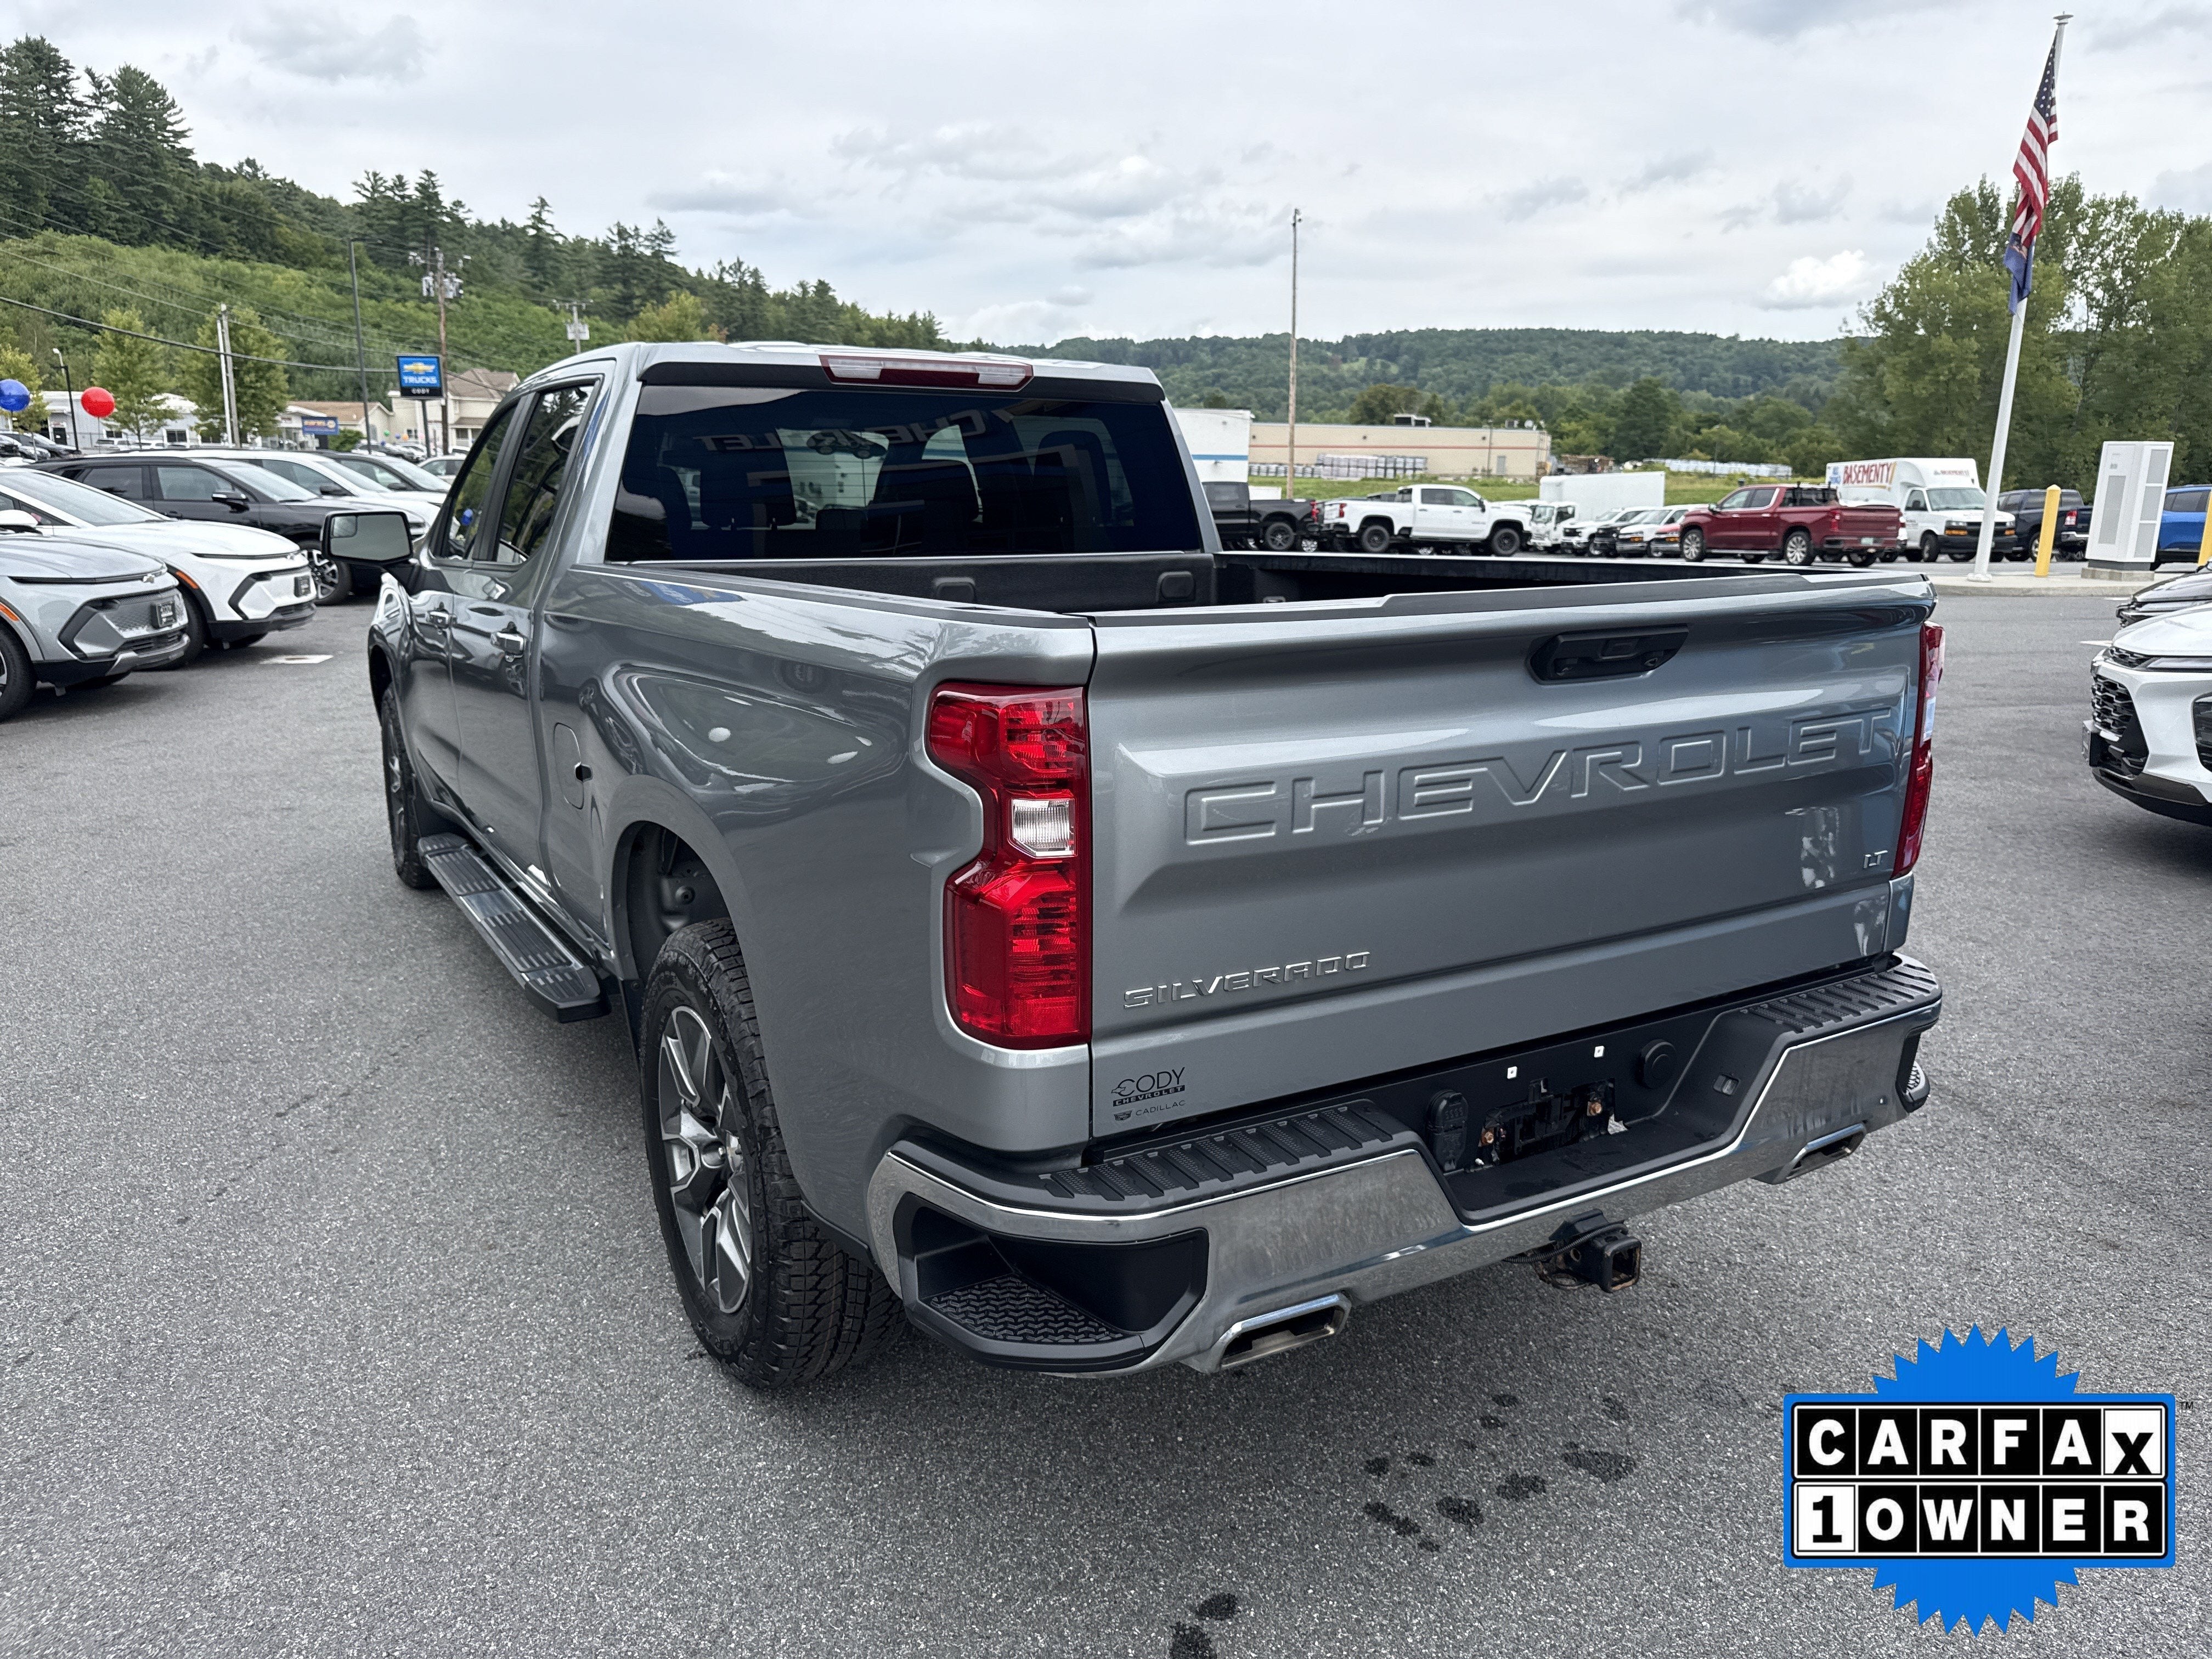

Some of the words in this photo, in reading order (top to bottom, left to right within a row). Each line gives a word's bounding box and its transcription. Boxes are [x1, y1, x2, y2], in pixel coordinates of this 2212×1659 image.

[1183, 706, 1892, 845] CHEVROLET
[1864, 850, 1888, 868] LT
[1124, 951, 1370, 1009] SILVERADO
[1114, 1066, 1186, 1097] CODY
[1115, 1086, 1183, 1106] CHEVROLET
[1136, 1100, 1186, 1116] CADILLAC
